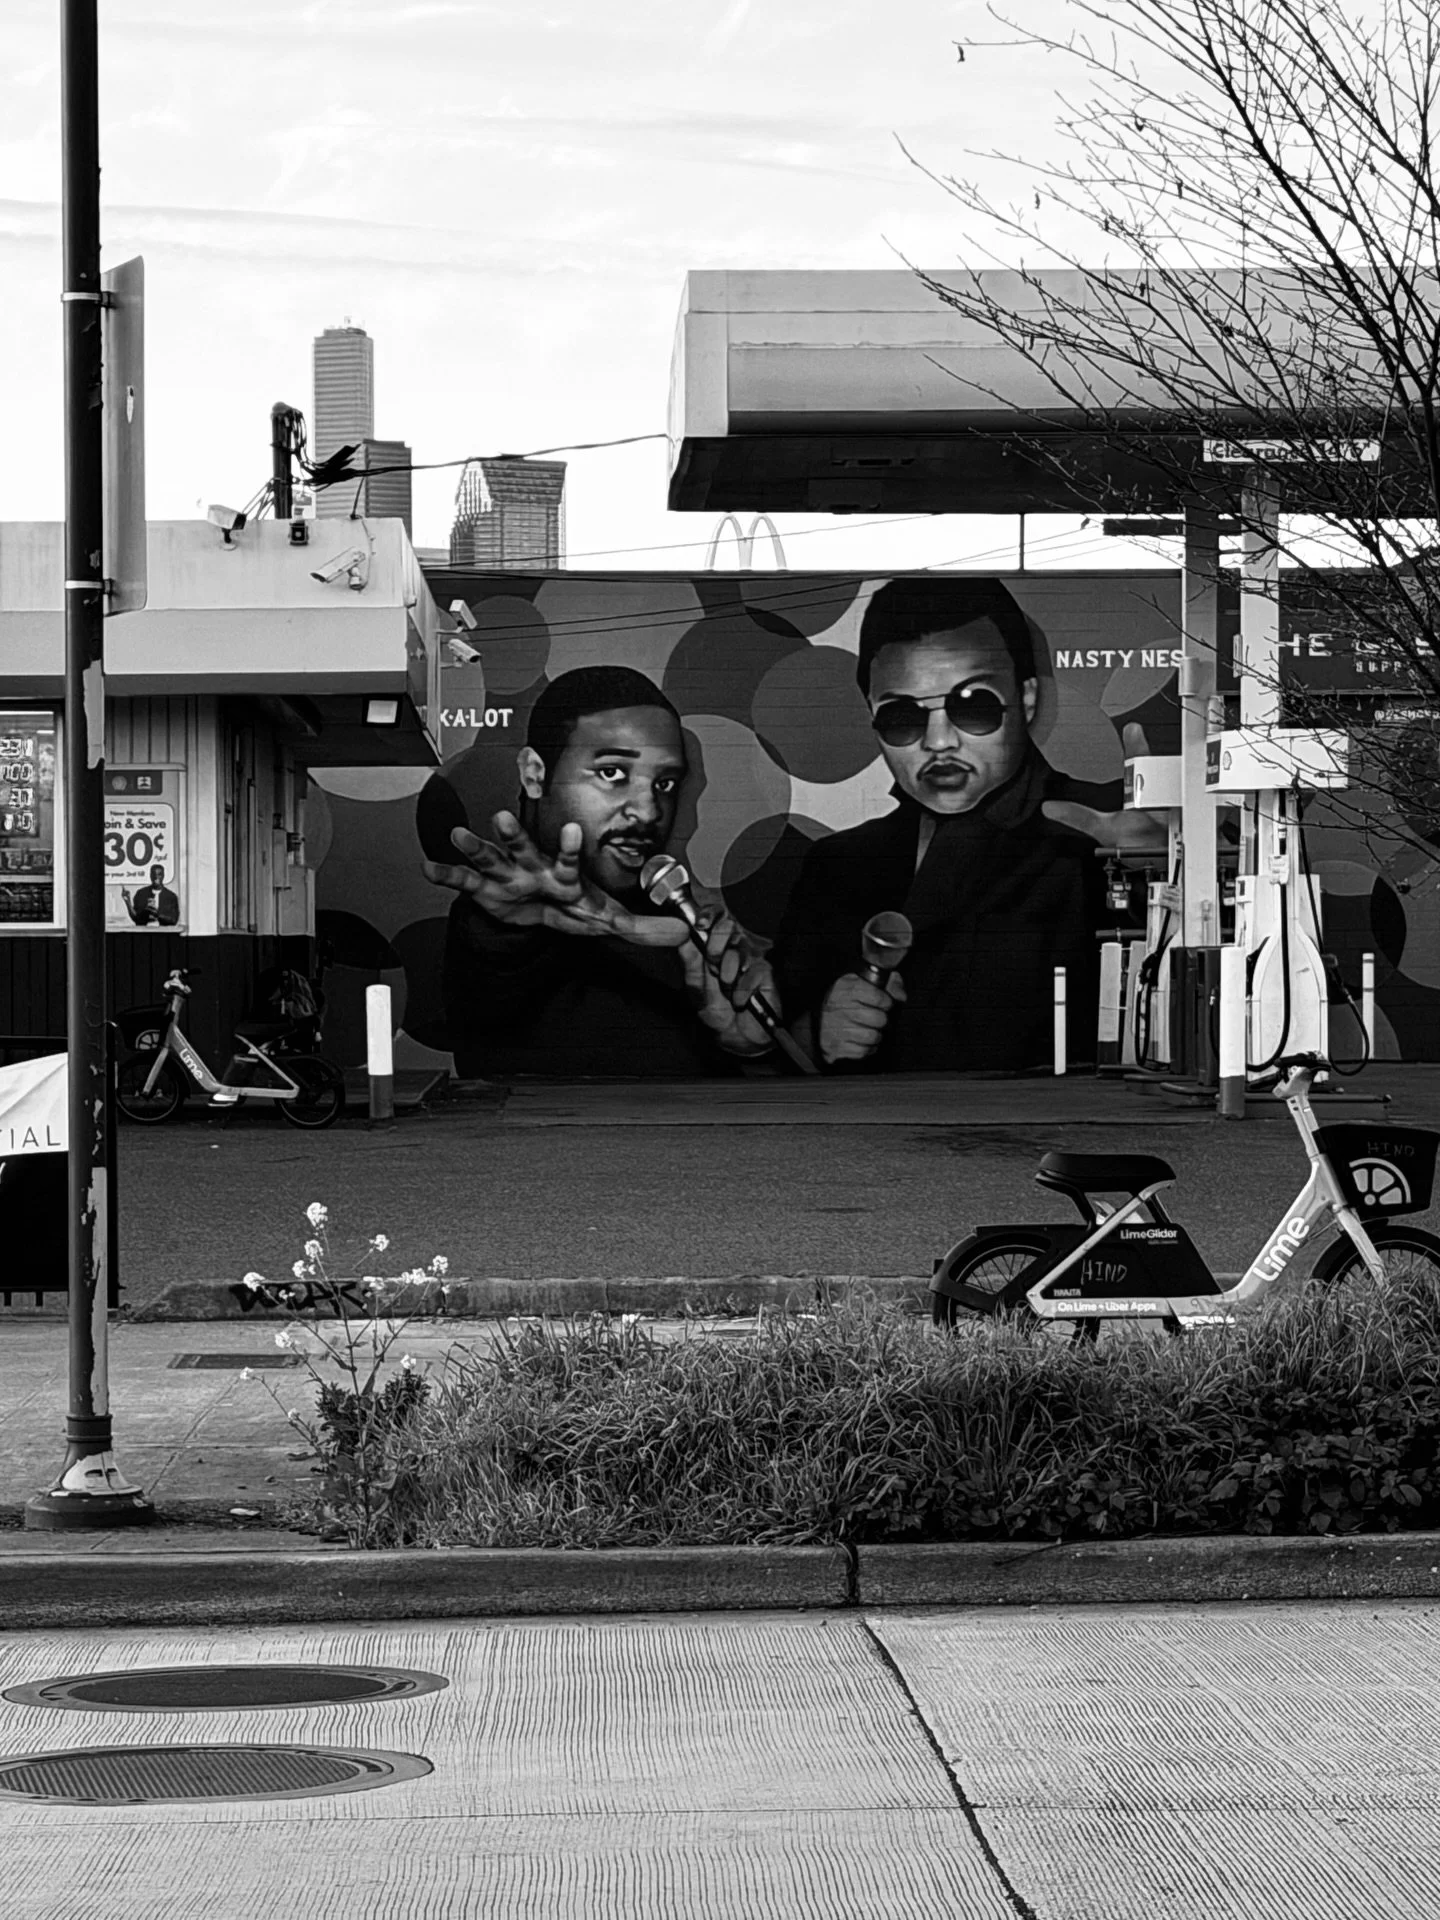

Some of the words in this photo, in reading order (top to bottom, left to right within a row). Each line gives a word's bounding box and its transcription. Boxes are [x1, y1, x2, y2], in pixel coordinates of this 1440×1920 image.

[1213, 442, 1305, 461] Cleran
[1056, 650, 1134, 668] NASTY
[104, 817, 122, 829] oin
[125, 818, 134, 829] &
[137, 817, 167, 829] Save
[180, 1048, 203, 1080] Lime
[0, 1125, 61, 1150] IAL
[1120, 1229, 1178, 1240] LimeGlider
[1252, 1217, 1309, 1281] Lime
[1080, 1259, 1128, 1285] HIND
[1074, 1302, 1097, 1312] Lime
[1131, 1301, 1157, 1313] Apps
